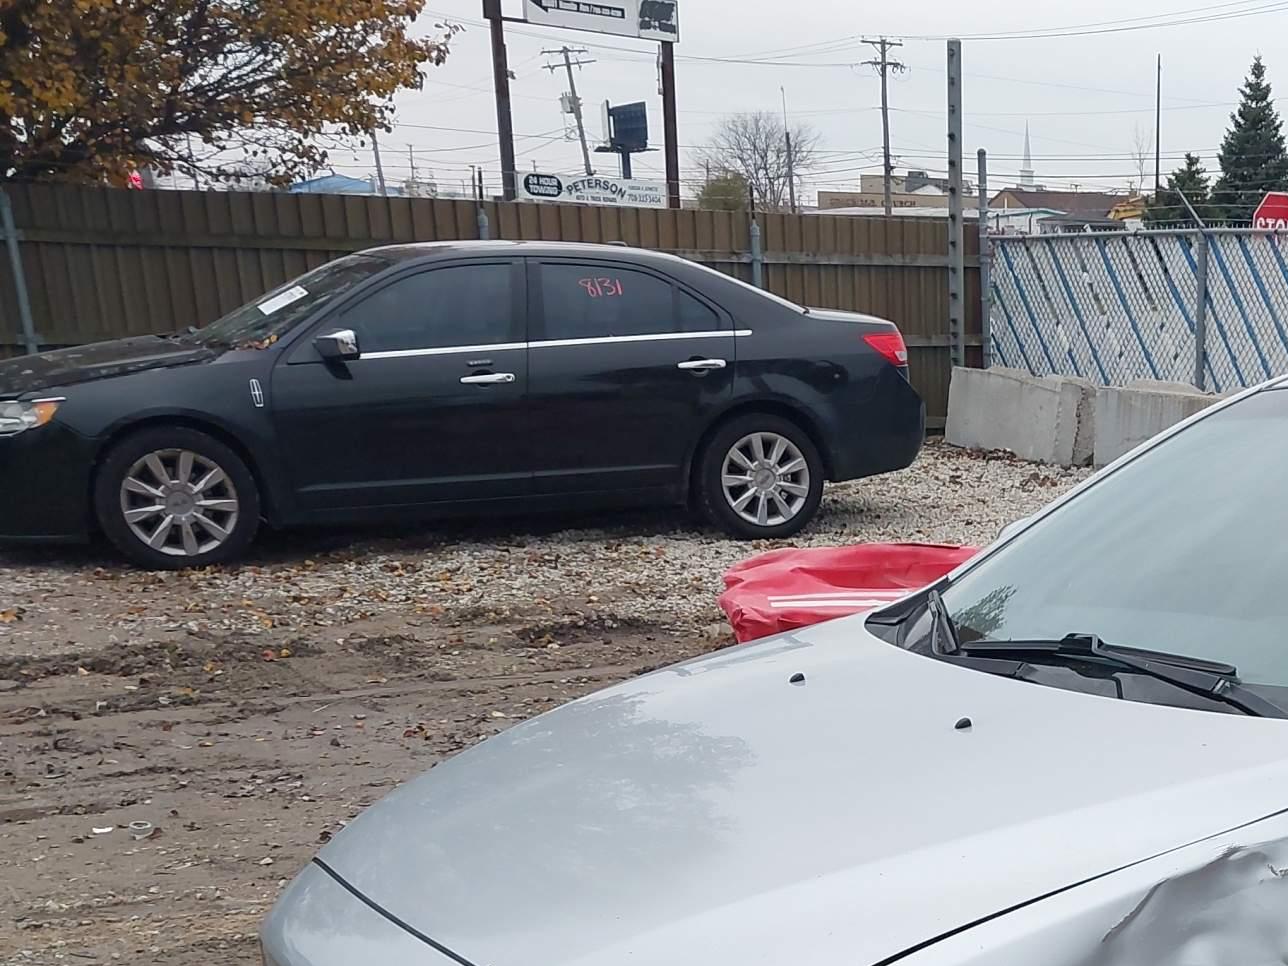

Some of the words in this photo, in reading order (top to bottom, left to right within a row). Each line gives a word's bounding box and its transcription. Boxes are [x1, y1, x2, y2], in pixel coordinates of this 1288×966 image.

[528, 175, 538, 184] 24
[539, 176, 558, 186] HOUR
[566, 178, 627, 199] PETERSON
[578, 277, 623, 297] 8131
